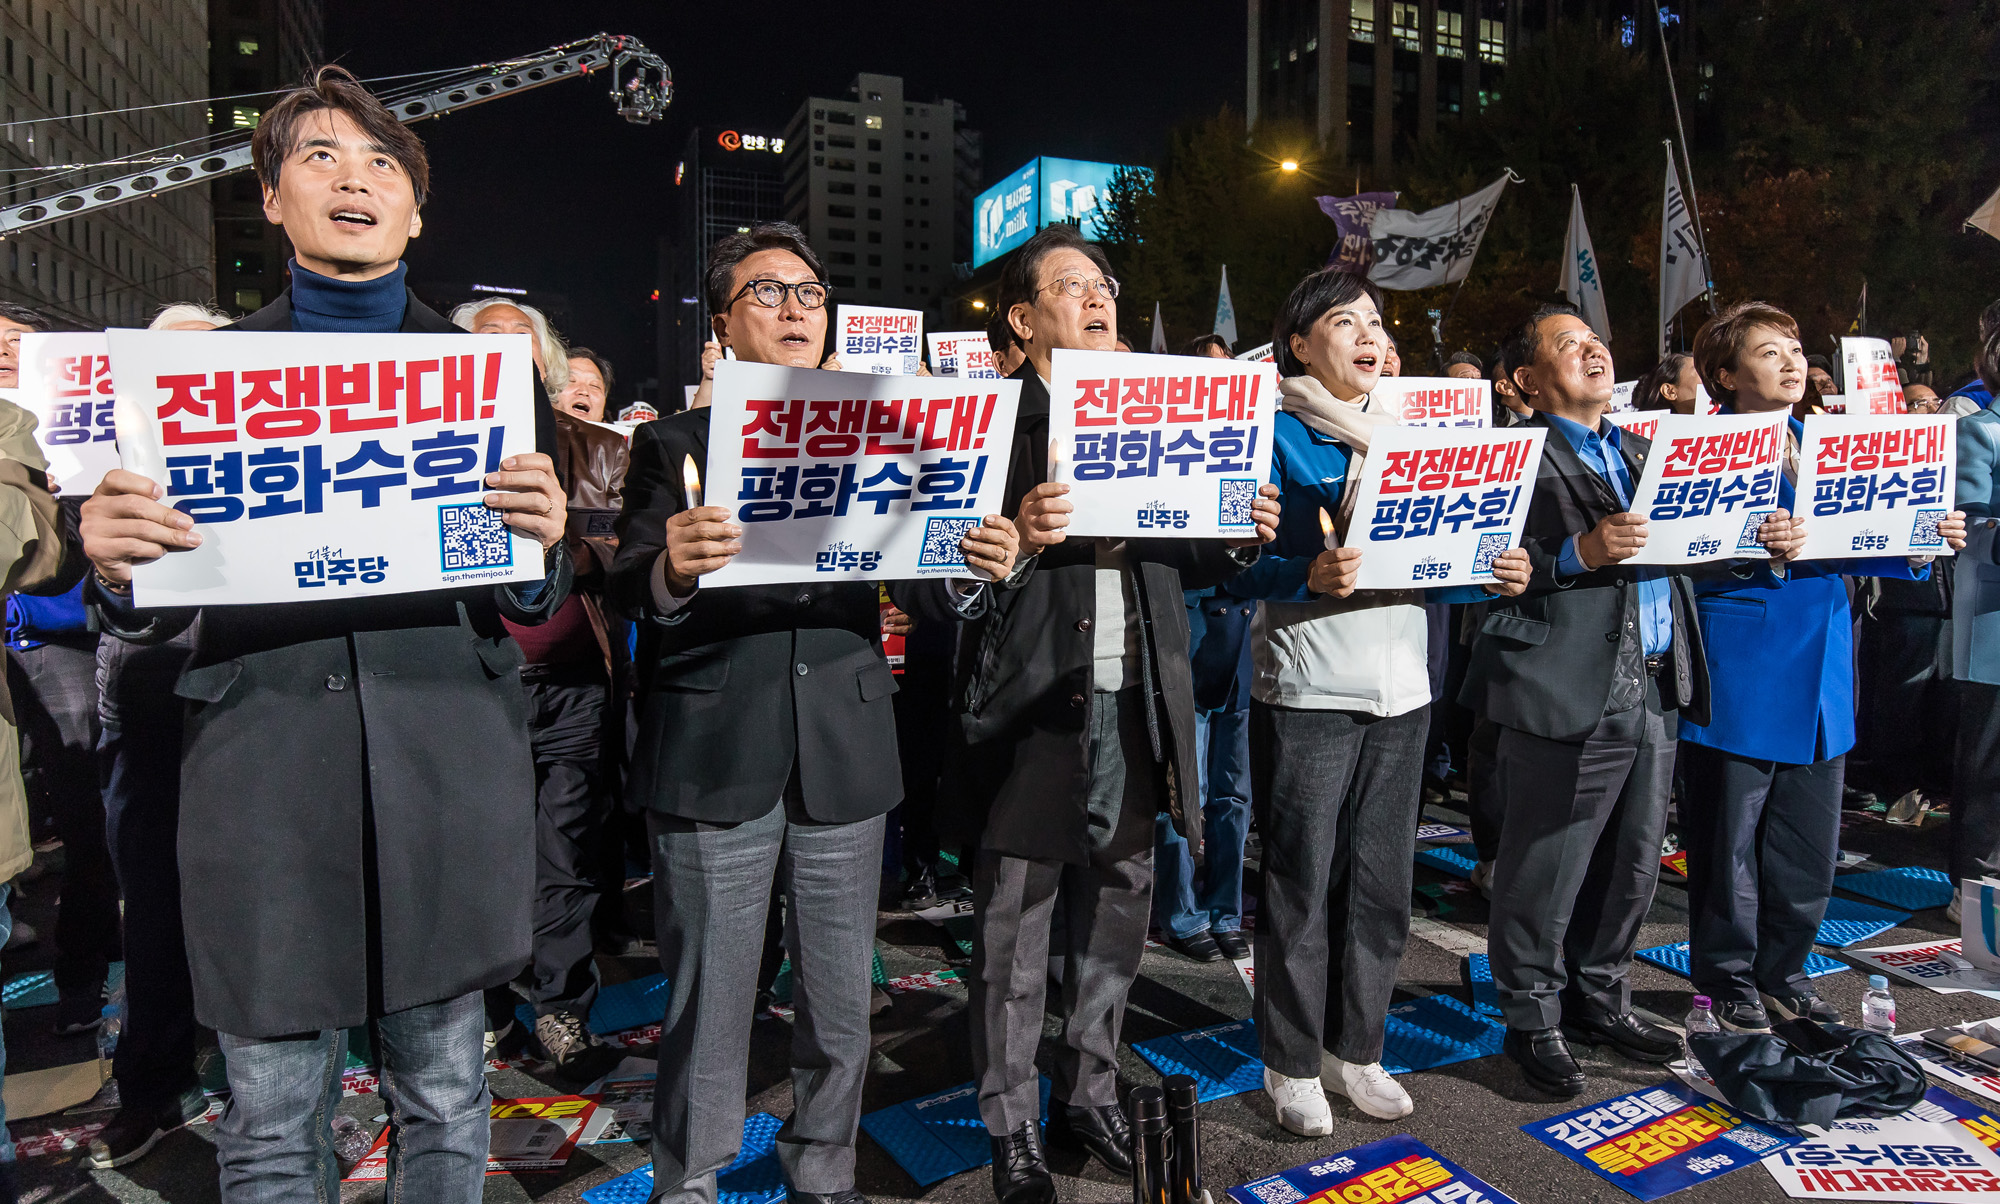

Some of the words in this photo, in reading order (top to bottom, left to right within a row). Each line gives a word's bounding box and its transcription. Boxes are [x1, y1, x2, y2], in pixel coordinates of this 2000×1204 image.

[846, 315, 918, 334] 전쟁반대!
[846, 335, 918, 354] 평화수호!
[871, 364, 892, 374] 민주당
[156, 352, 502, 446] 전쟁반대!
[1074, 374, 1261, 427] 전쟁반대!
[741, 393, 998, 458] 전쟁반대!
[1073, 425, 1259, 481] 평화수호!
[1661, 421, 1784, 478] 전쟁반대!
[1816, 424, 1947, 475] 전쟁반대!
[165, 425, 505, 524] 평화수호!
[1379, 439, 1533, 494] 전쟁반대!
[737, 455, 989, 523] 평화수호!
[1649, 468, 1779, 521] 평화수호!
[1813, 466, 1945, 517] 평화수호!
[1146, 500, 1166, 511] 더불어
[1369, 485, 1522, 542] 평화수호!
[1137, 510, 1190, 529] 민주당
[307, 546, 343, 561] 더불어
[827, 541, 853, 552] 더불어
[1687, 539, 1722, 557] 민주당
[1851, 534, 1889, 550] 민주당
[294, 556, 389, 588] 민주당
[815, 551, 883, 572] 민주당
[916, 567, 971, 575] sign.theminjoo.kr
[1412, 562, 1452, 580] 민주당
[442, 568, 514, 583] sign.theminjoo.kr
[1545, 1089, 1687, 1150] 김건희를
[1584, 1102, 1742, 1174] 특검하라!
[1308, 1156, 1356, 1176] 민주당
[1687, 1154, 1735, 1175] 민주당
[1779, 1144, 1982, 1167] 평화수호!
[1796, 1168, 2000, 1192] 전쟁반대!
